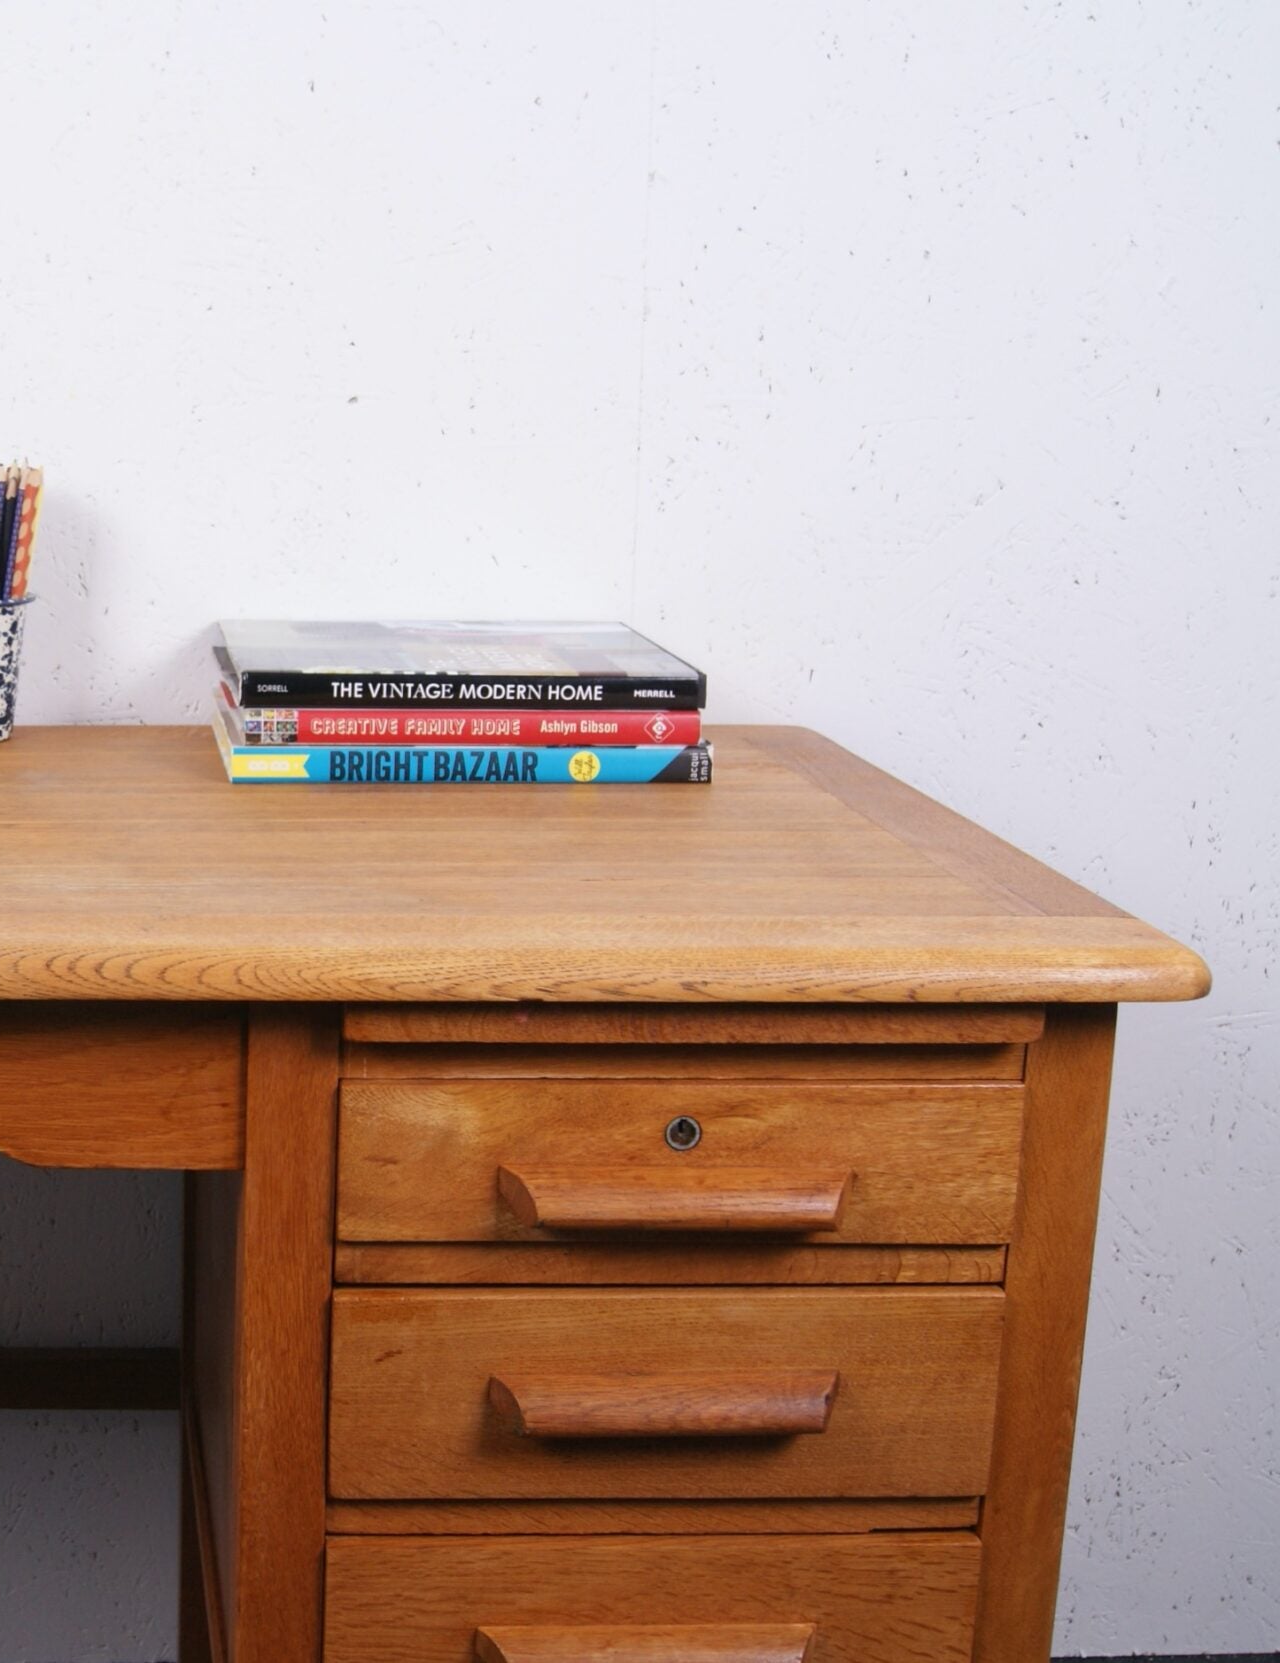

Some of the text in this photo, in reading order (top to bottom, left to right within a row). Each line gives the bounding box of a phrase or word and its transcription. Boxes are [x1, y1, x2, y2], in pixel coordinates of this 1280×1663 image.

[257, 684, 288, 693] SORRELL
[331, 682, 604, 701] THE VINTAGE MODERN HOME
[633, 689, 676, 698] MERRELL
[310, 718, 521, 735] CREATIVE FAMILY HOME
[540, 719, 618, 734] Ashlyn Gibson
[329, 751, 538, 782] BRIGHT BAZAAR
[689, 752, 699, 781] jacqui
[699, 752, 709, 781] small
